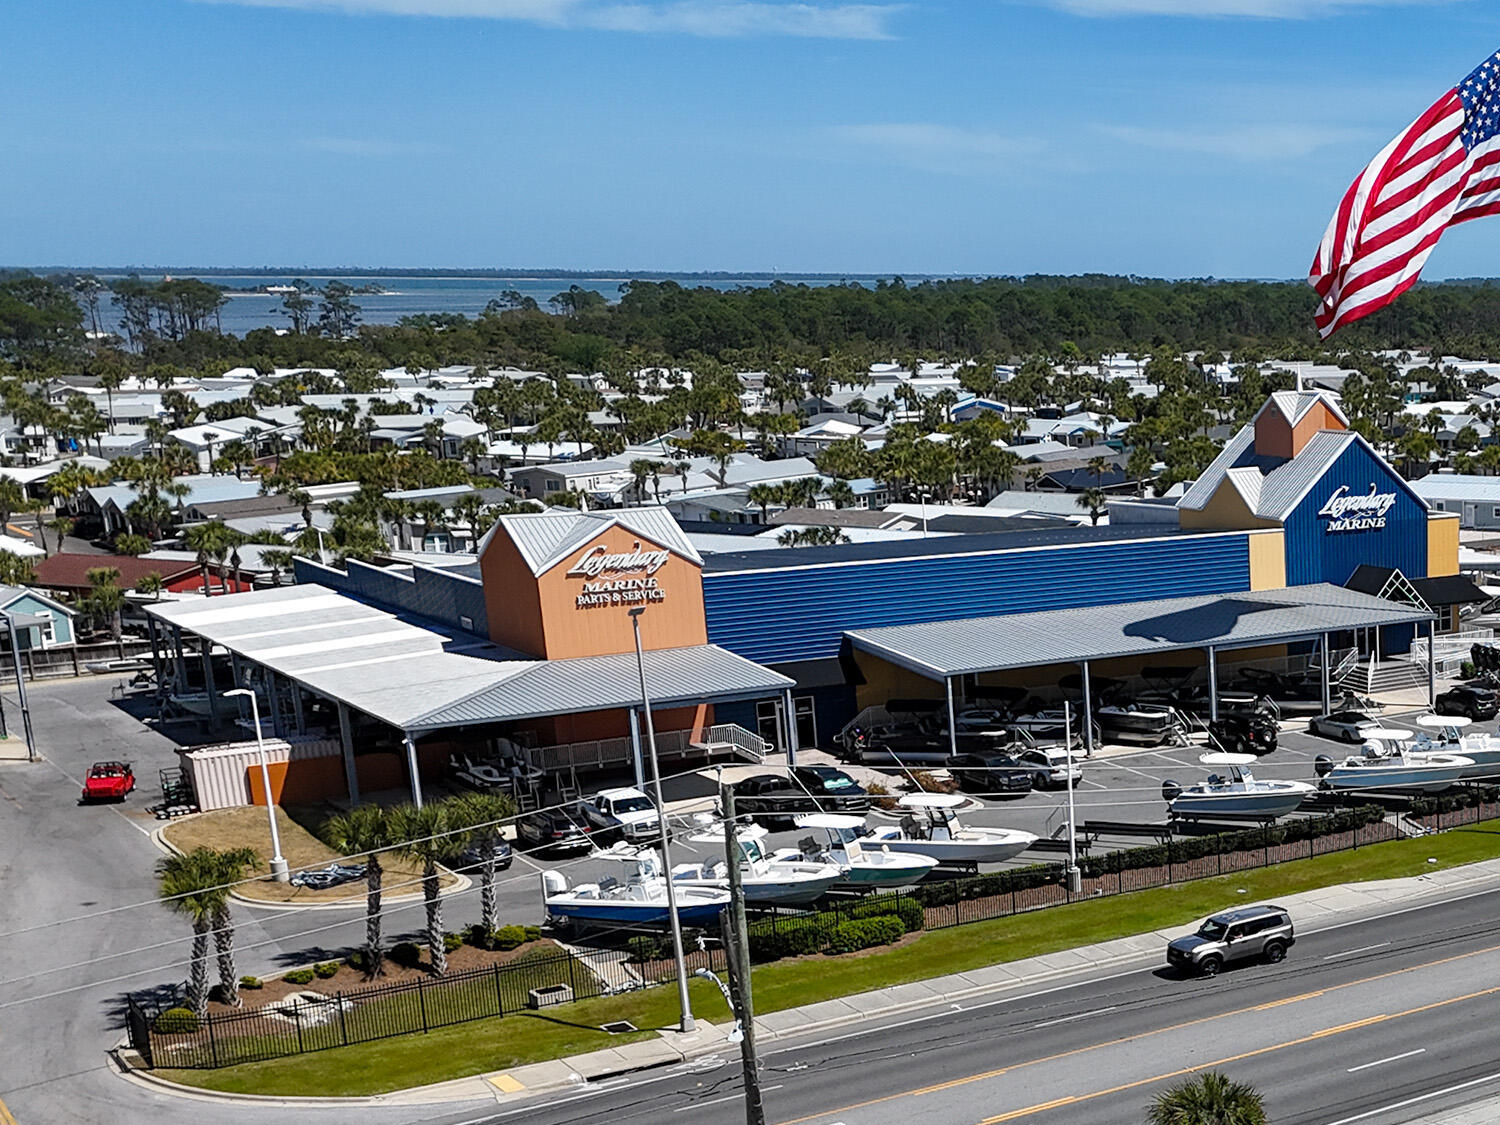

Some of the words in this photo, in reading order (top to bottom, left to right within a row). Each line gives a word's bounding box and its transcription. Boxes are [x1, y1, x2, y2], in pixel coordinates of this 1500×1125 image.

[1318, 482, 1397, 518] Legendary
[1327, 517, 1386, 531] MARINE
[567, 540, 670, 576] Legendary
[583, 578, 658, 593] MARINE
[576, 592, 610, 605] PARTS
[612, 592, 621, 602] &
[622, 588, 666, 601] SERVICE
